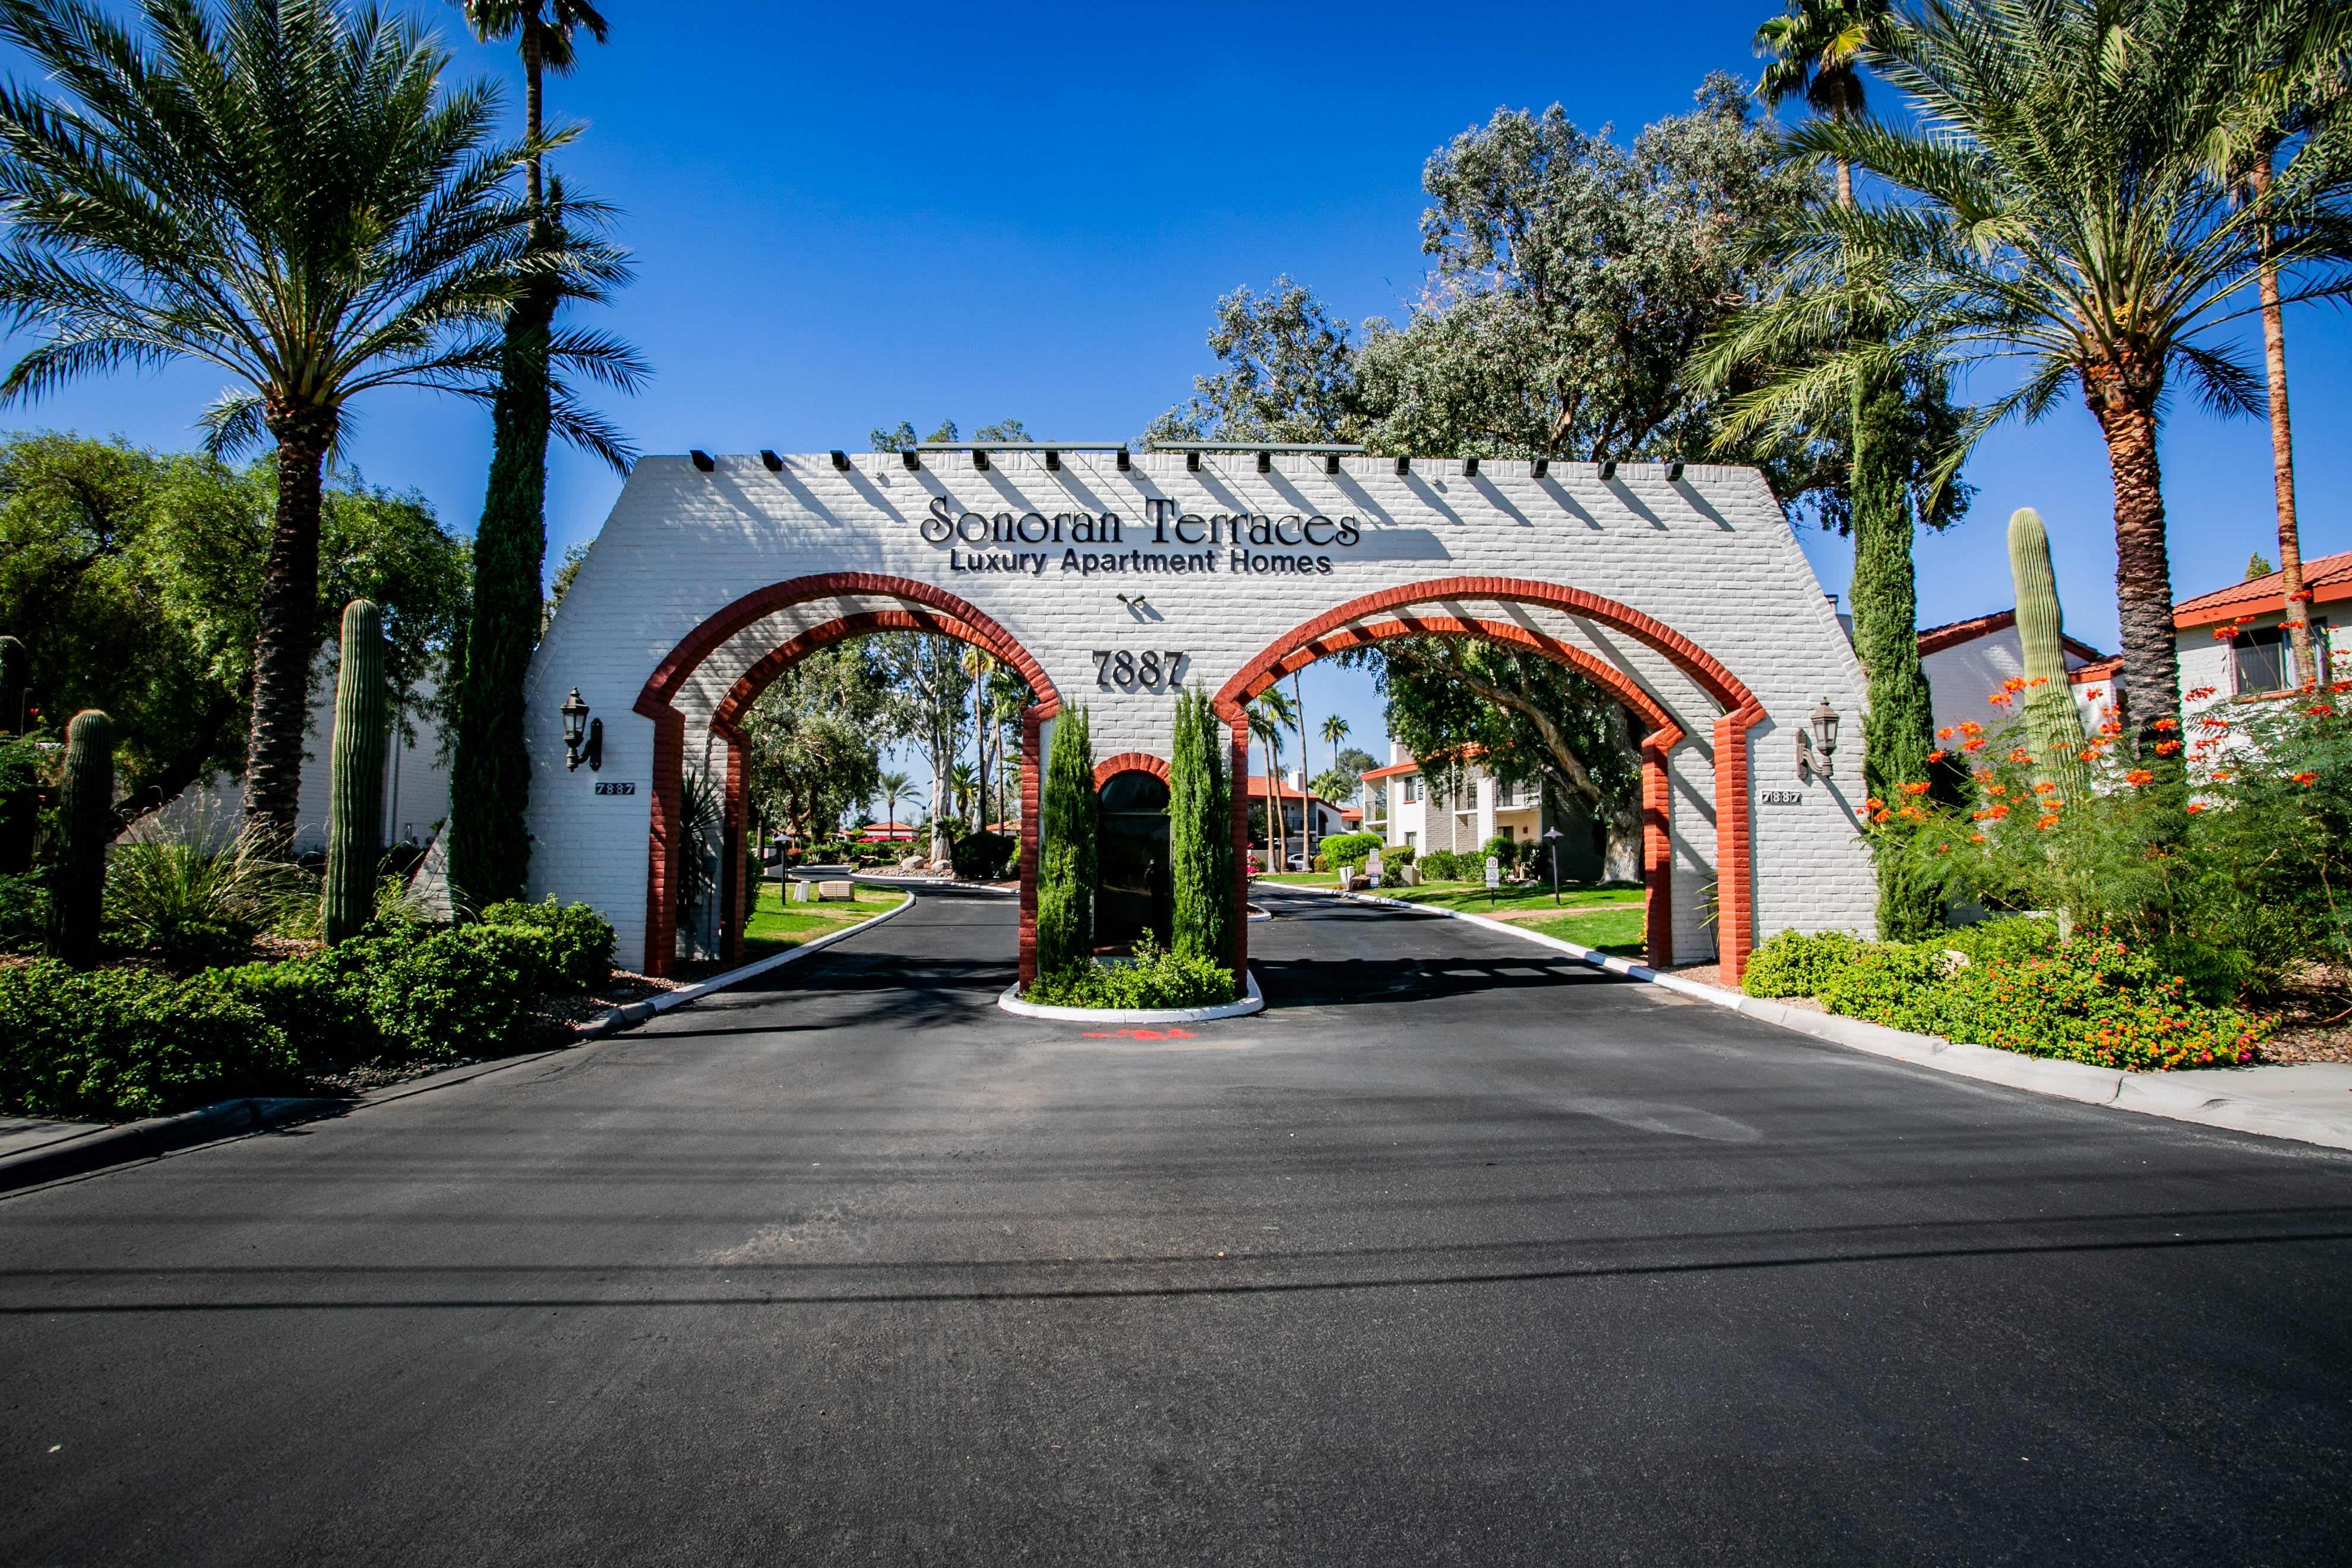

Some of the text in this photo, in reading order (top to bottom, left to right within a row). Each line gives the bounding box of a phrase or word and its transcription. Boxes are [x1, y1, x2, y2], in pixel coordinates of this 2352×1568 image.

[919, 495, 1360, 546] Sonoran Terraces
[950, 548, 1331, 576] Luxury Apartment Homes
[1092, 650, 1184, 685] 7887
[596, 783, 634, 795] 7887
[1762, 791, 1801, 803] 7887
